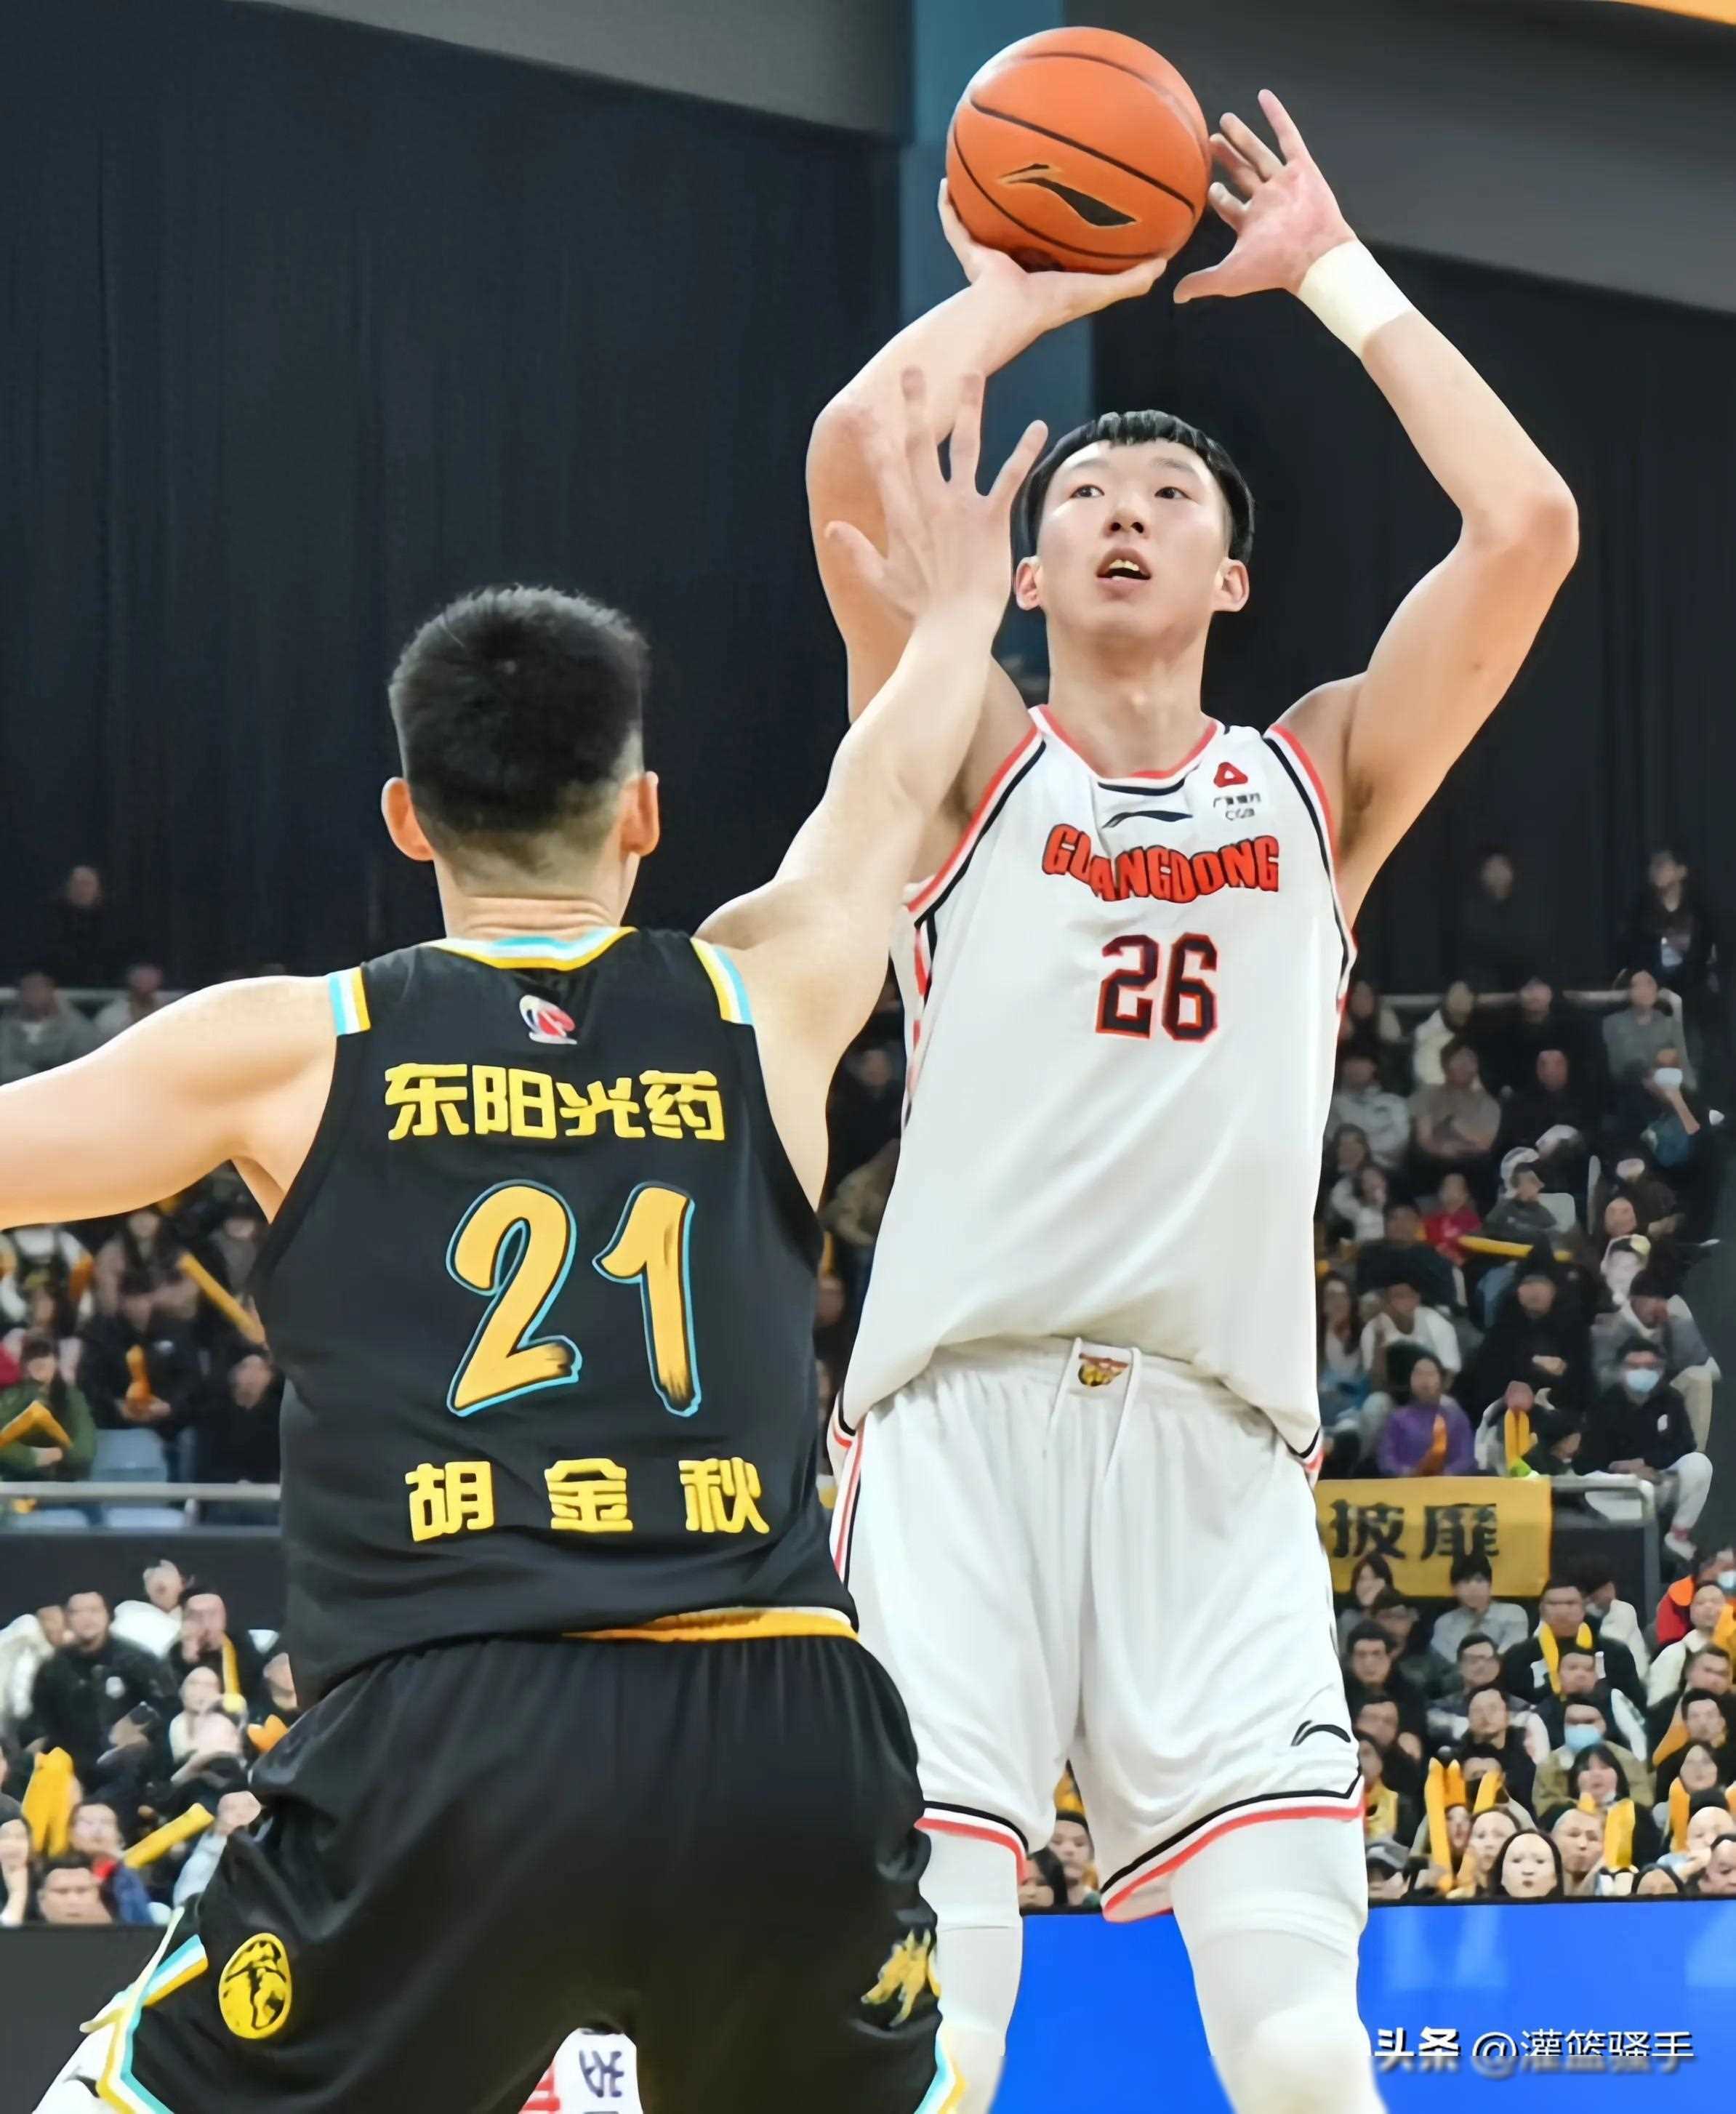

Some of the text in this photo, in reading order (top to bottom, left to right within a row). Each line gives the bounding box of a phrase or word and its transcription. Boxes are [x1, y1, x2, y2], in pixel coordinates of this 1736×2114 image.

[1042, 823, 1279, 904] GUANGDONG
[1096, 932, 1218, 1042] 26
[384, 1063, 726, 1141] 东阳光药
[446, 1178, 702, 1418] 21
